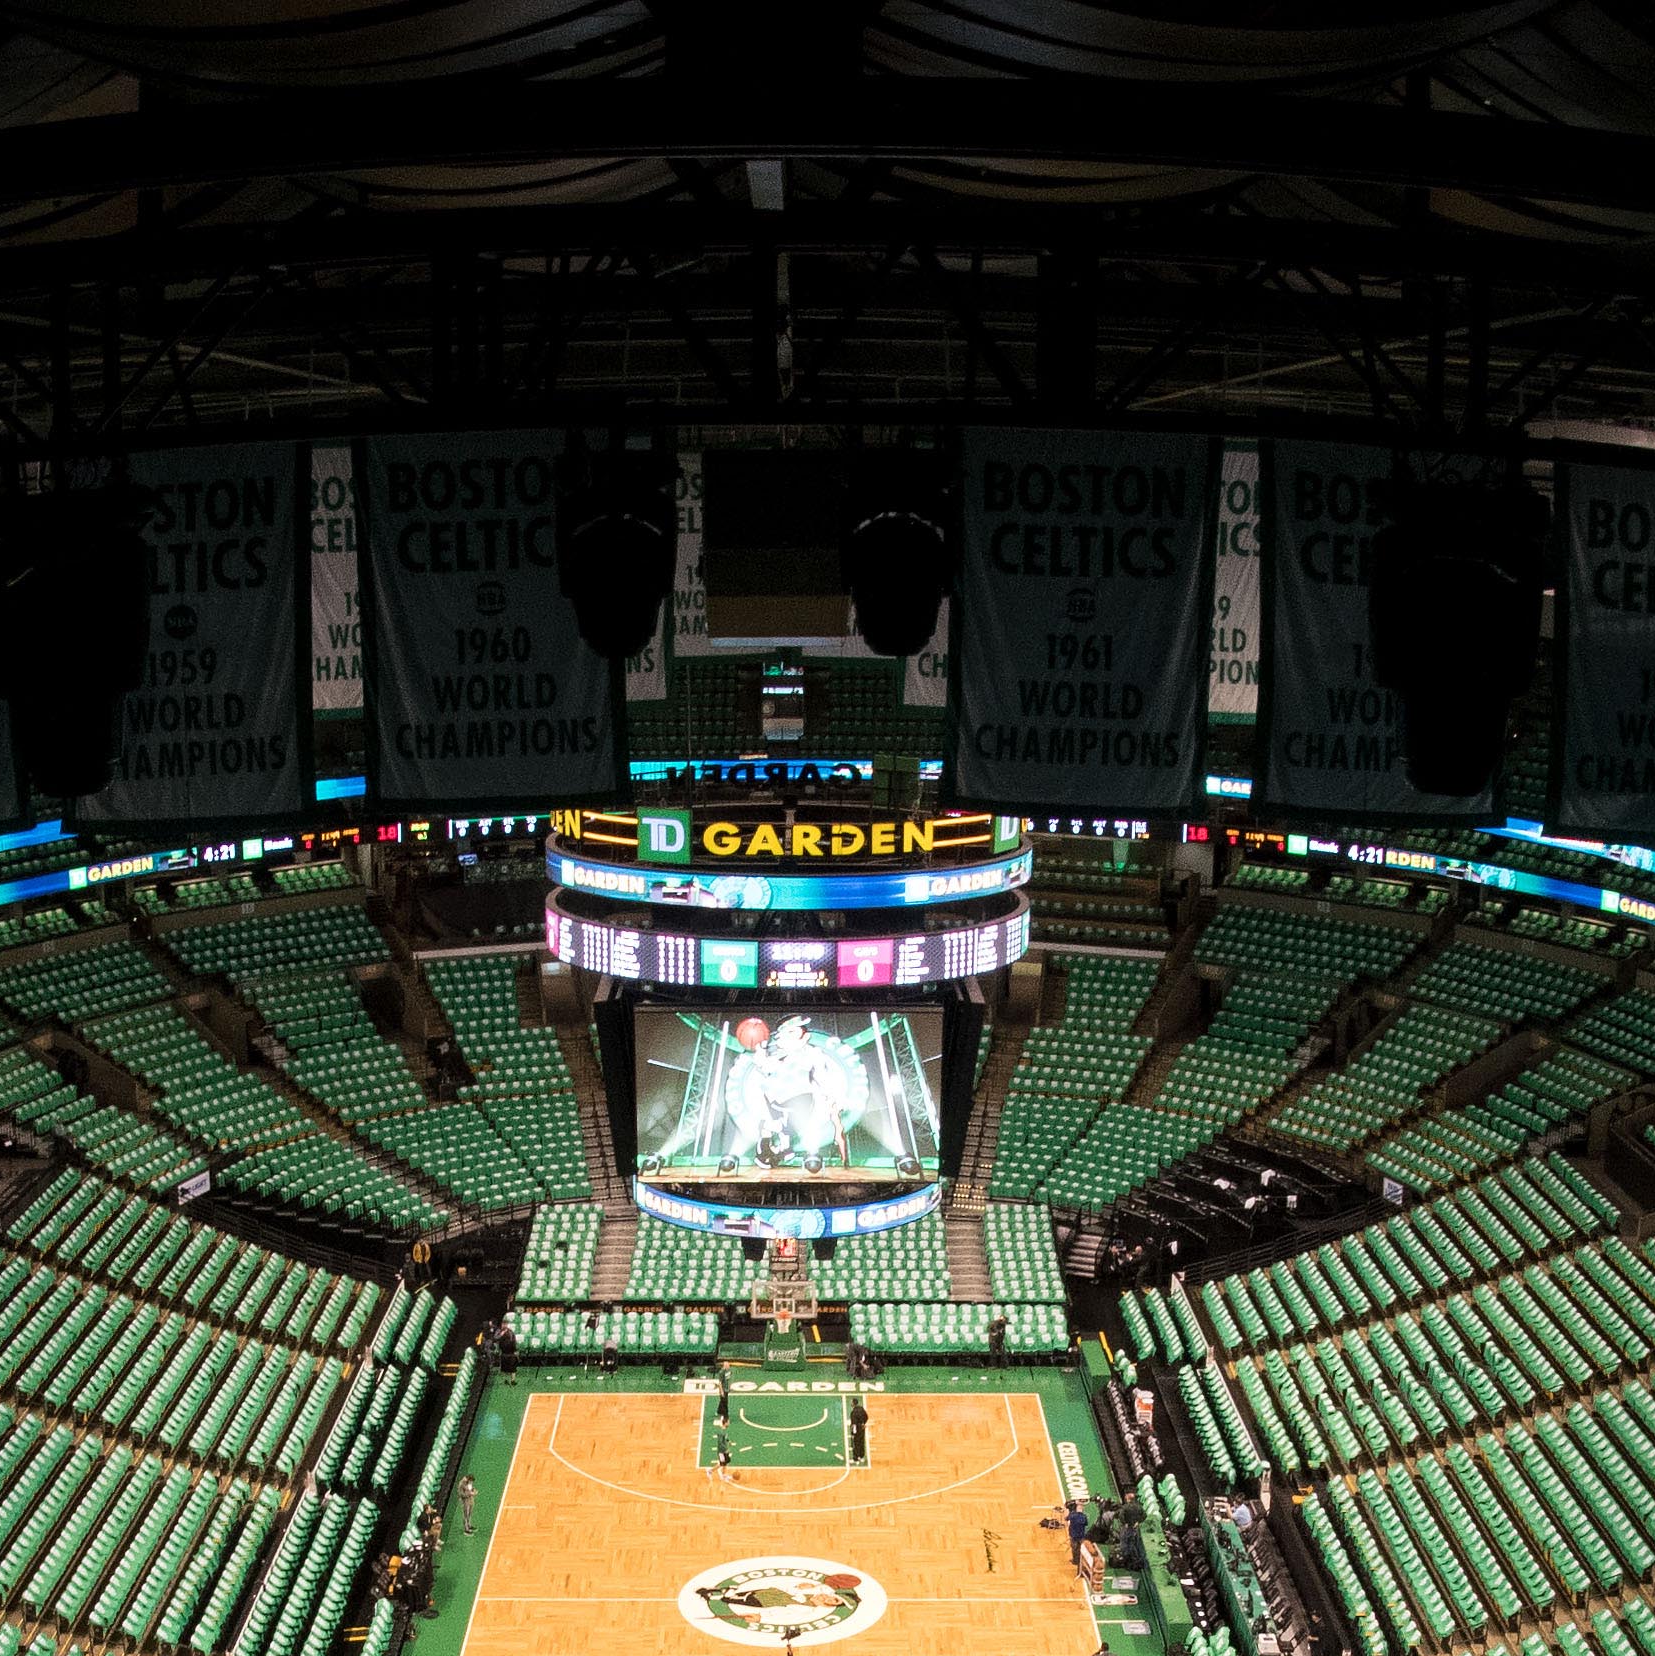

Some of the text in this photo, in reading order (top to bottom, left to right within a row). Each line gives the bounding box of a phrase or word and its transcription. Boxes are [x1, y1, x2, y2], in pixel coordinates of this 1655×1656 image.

[388, 458, 552, 513] BOSTO
[984, 462, 1187, 518] BOSTON
[148, 478, 276, 534] STON
[399, 516, 557, 572] CELTIC
[991, 523, 1176, 577] CELTICS
[148, 538, 267, 594] LTICS
[455, 627, 530, 665] 1960
[1047, 634, 1113, 670] 1961
[148, 648, 217, 689] 1959
[432, 672, 557, 712] WORLD
[1018, 680, 1143, 719] WORLD
[122, 692, 245, 733] WORLD
[395, 717, 597, 758] CHAMPIONS
[975, 726, 1180, 767] CHAMPIONS
[121, 736, 286, 780] AMPIONS
[377, 826, 397, 842] 18
[642, 817, 934, 856] TD GARDEN
[1189, 827, 1209, 840] 18
[204, 844, 236, 862] 4:21
[1348, 845, 1384, 865] 4:21
[1386, 851, 1436, 869] RDEN
[88, 857, 153, 882] GARDEN
[575, 867, 645, 893] GARDEN
[932, 870, 1003, 896] GARDEN
[720, 960, 737, 981] 0
[857, 959, 874, 981] 0
[645, 1194, 708, 1225] GARDEN
[857, 1196, 926, 1227] GARDEN
[623, 1306, 663, 1314] GARDEN
[686, 1306, 725, 1314] GARDEN
[816, 1306, 848, 1314] ARDEN
[730, 1381, 884, 1392] GARDEN
[732, 1568, 823, 1585] BOSTON
